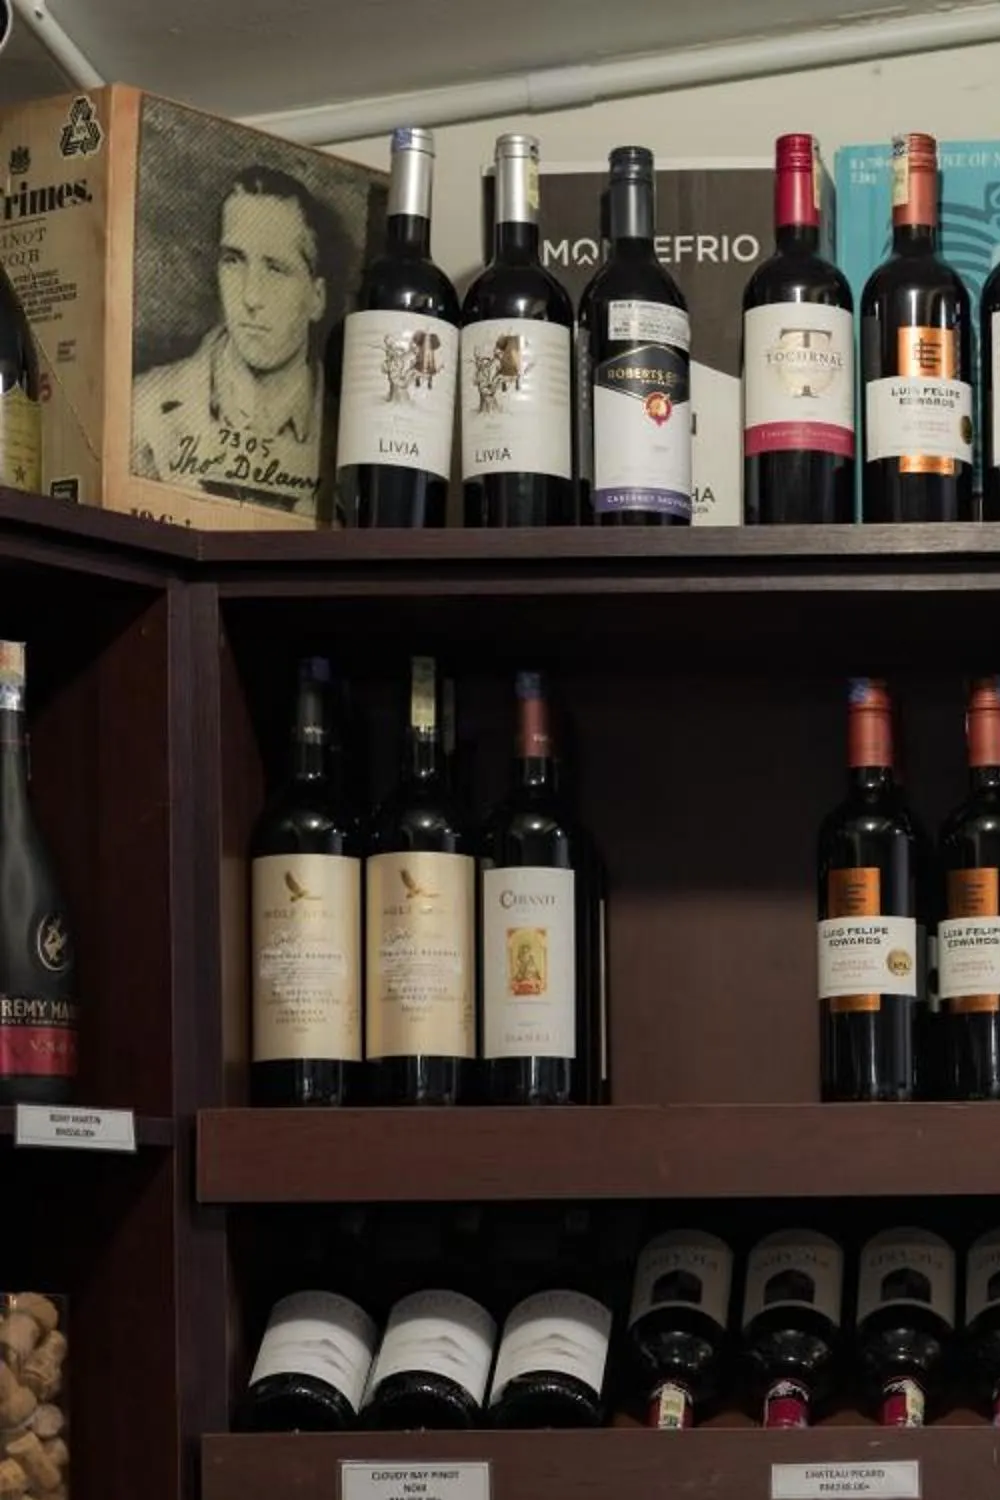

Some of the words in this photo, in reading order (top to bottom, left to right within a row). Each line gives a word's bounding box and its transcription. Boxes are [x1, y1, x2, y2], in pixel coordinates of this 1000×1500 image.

[0, 179, 94, 220] rimes.
[543, 234, 761, 266] MOEFRIO
[218, 428, 275, 458] 7305
[378, 437, 420, 457] LIVIA
